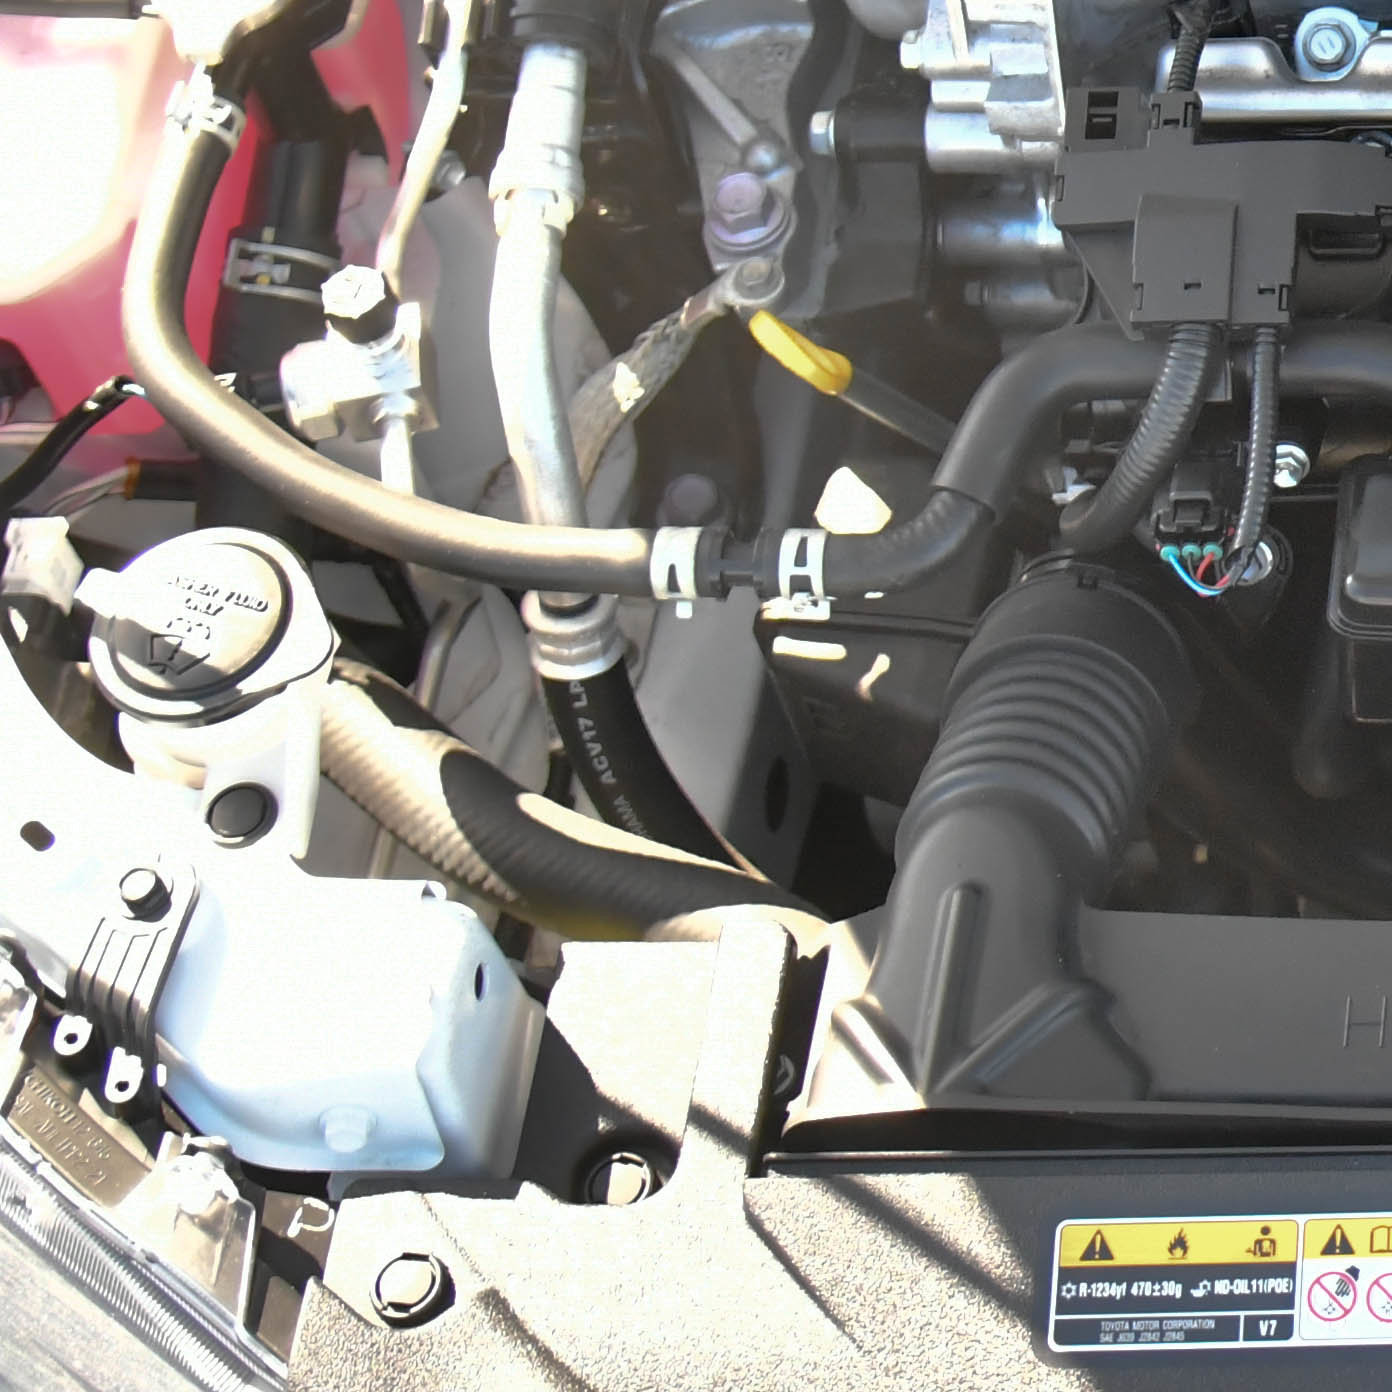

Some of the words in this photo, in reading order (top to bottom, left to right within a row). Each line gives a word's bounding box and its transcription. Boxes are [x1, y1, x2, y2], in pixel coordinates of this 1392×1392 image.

[577, 716, 617, 785] ACV17
[1078, 1281, 1127, 1300] R-1234yf
[1130, 1280, 1183, 1299] 470±30g
[1100, 1321, 1130, 1331] TOYOTA
[1132, 1320, 1160, 1330] MOTOR
[1162, 1319, 1216, 1330] CORPORATION
[1259, 1319, 1278, 1337] V7
